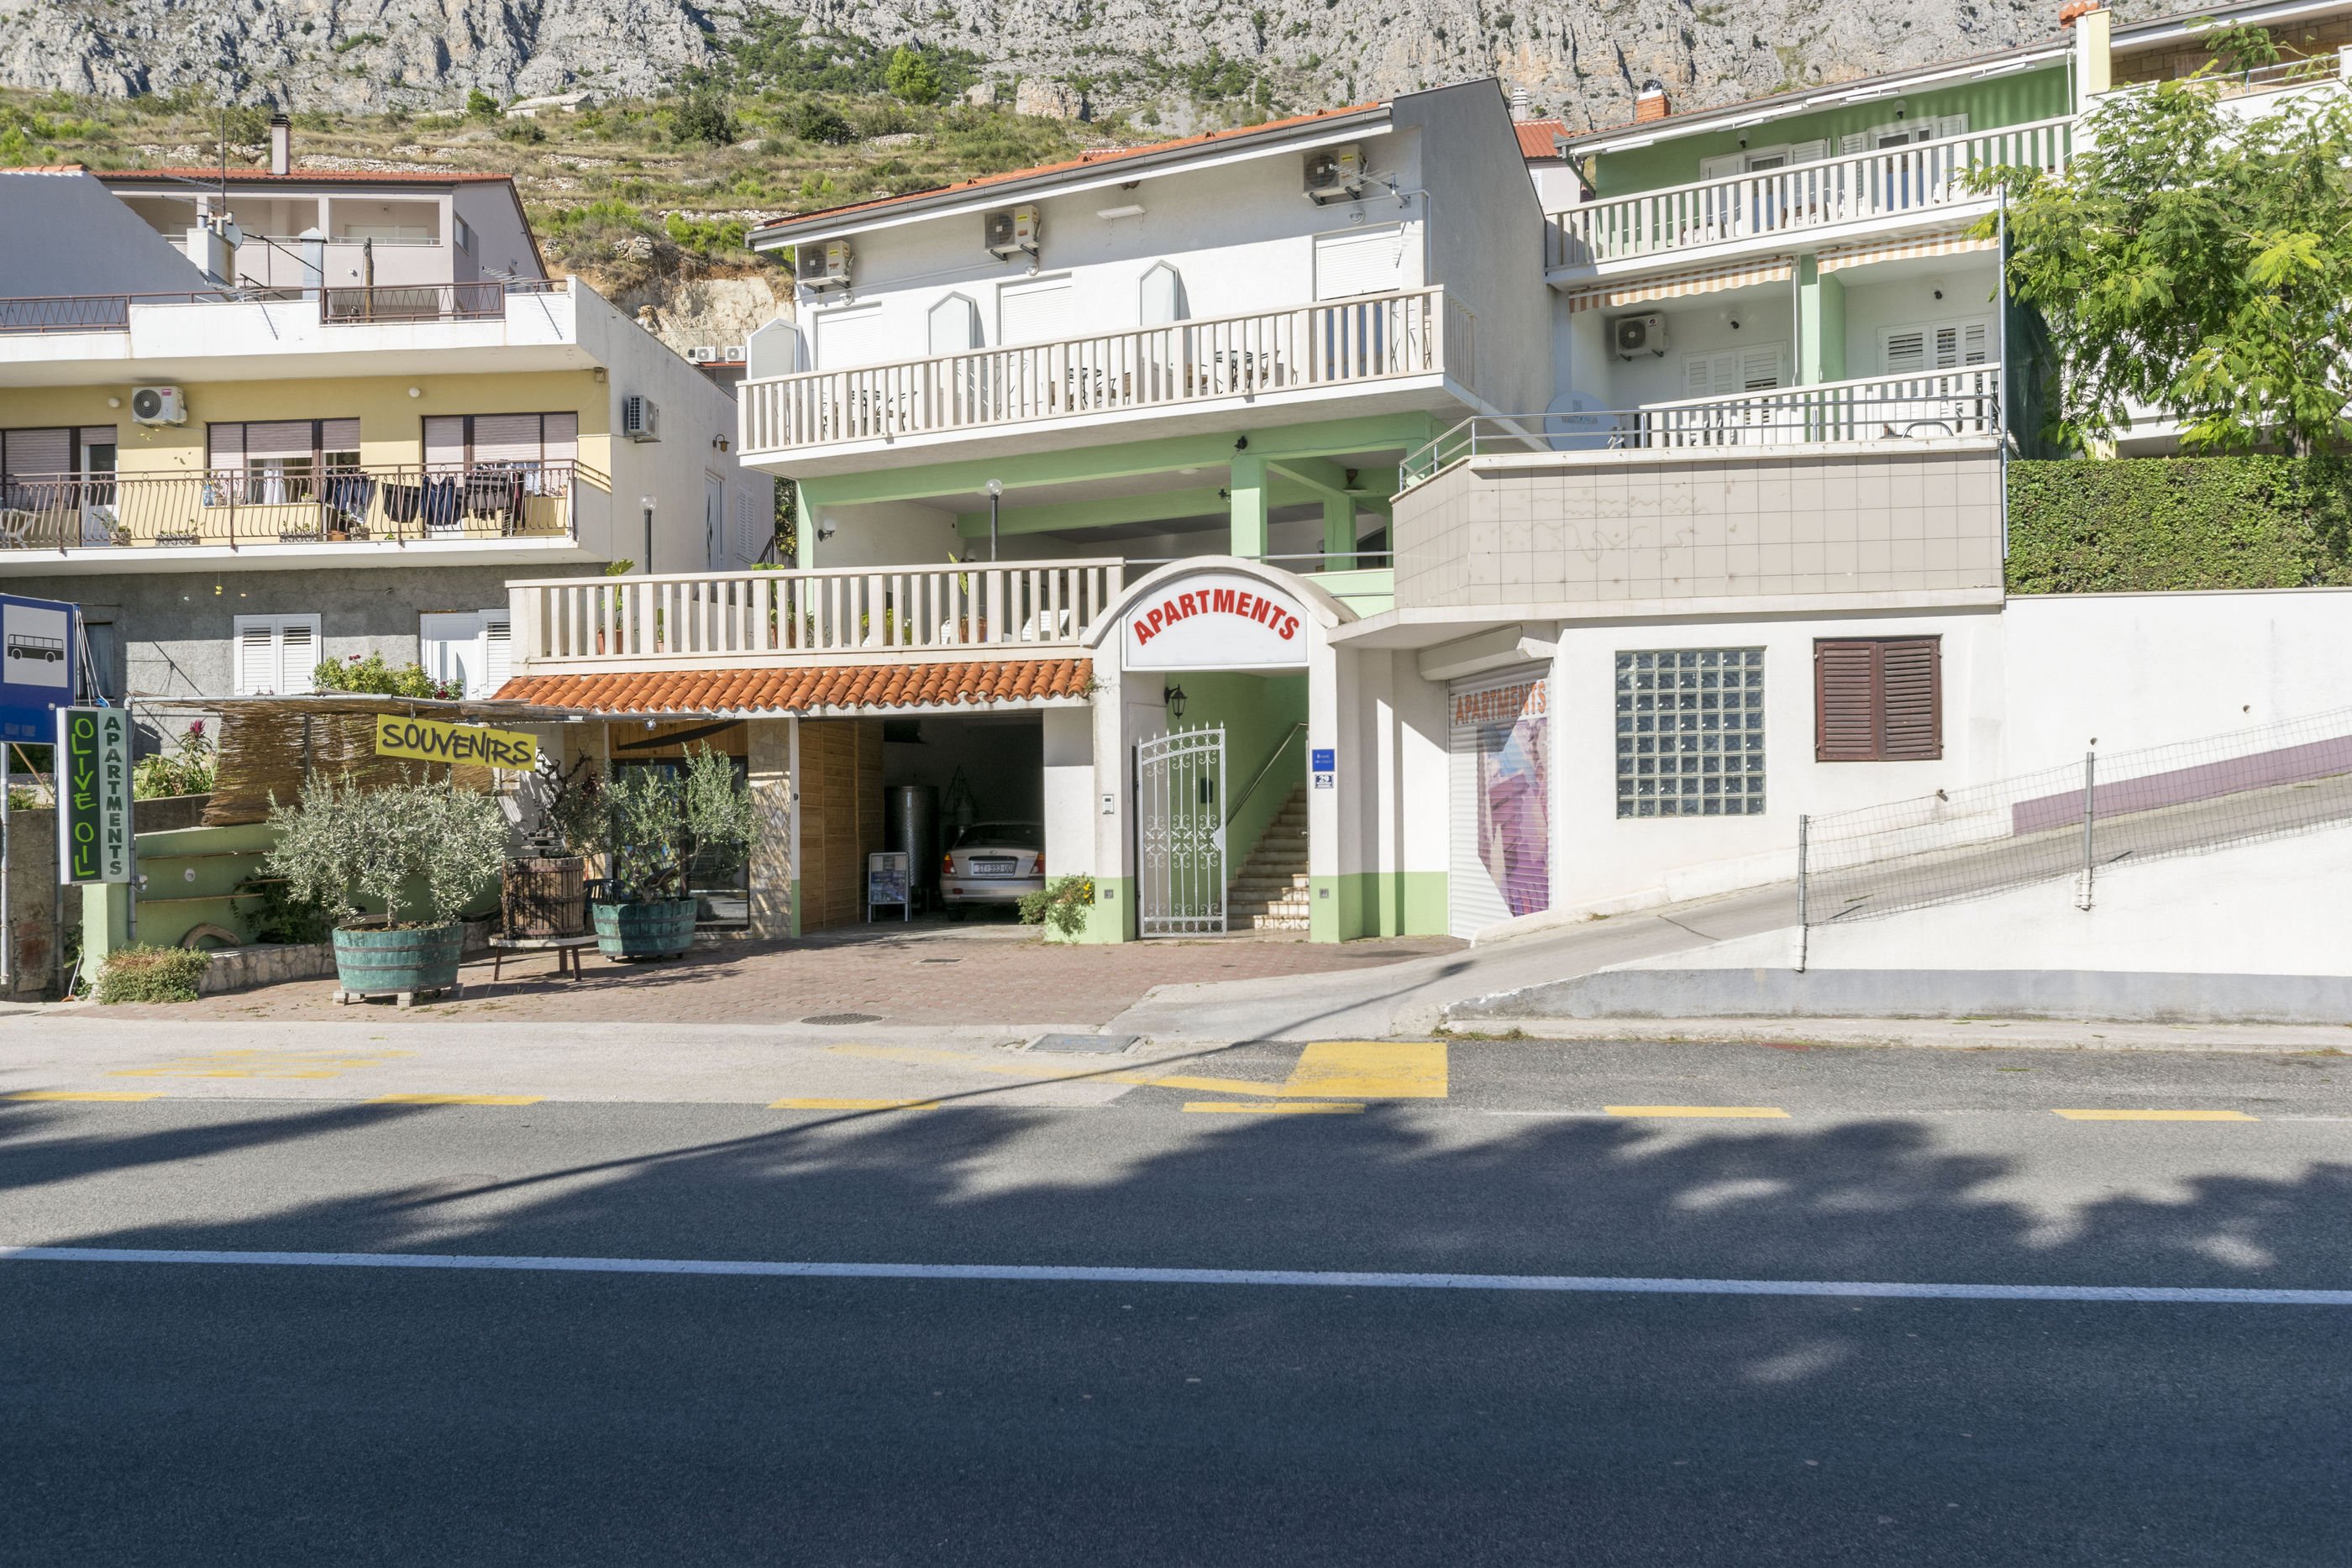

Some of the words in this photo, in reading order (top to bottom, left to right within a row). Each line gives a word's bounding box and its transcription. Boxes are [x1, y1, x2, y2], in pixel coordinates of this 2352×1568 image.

[1134, 589, 1299, 645] APARTMENTS
[1455, 681, 1546, 726] APARTMENTS
[71, 718, 97, 810] OLIVE
[382, 723, 532, 766] SOUVENIRS
[104, 716, 123, 875] APARTMENTS
[74, 822, 96, 877] OIL
